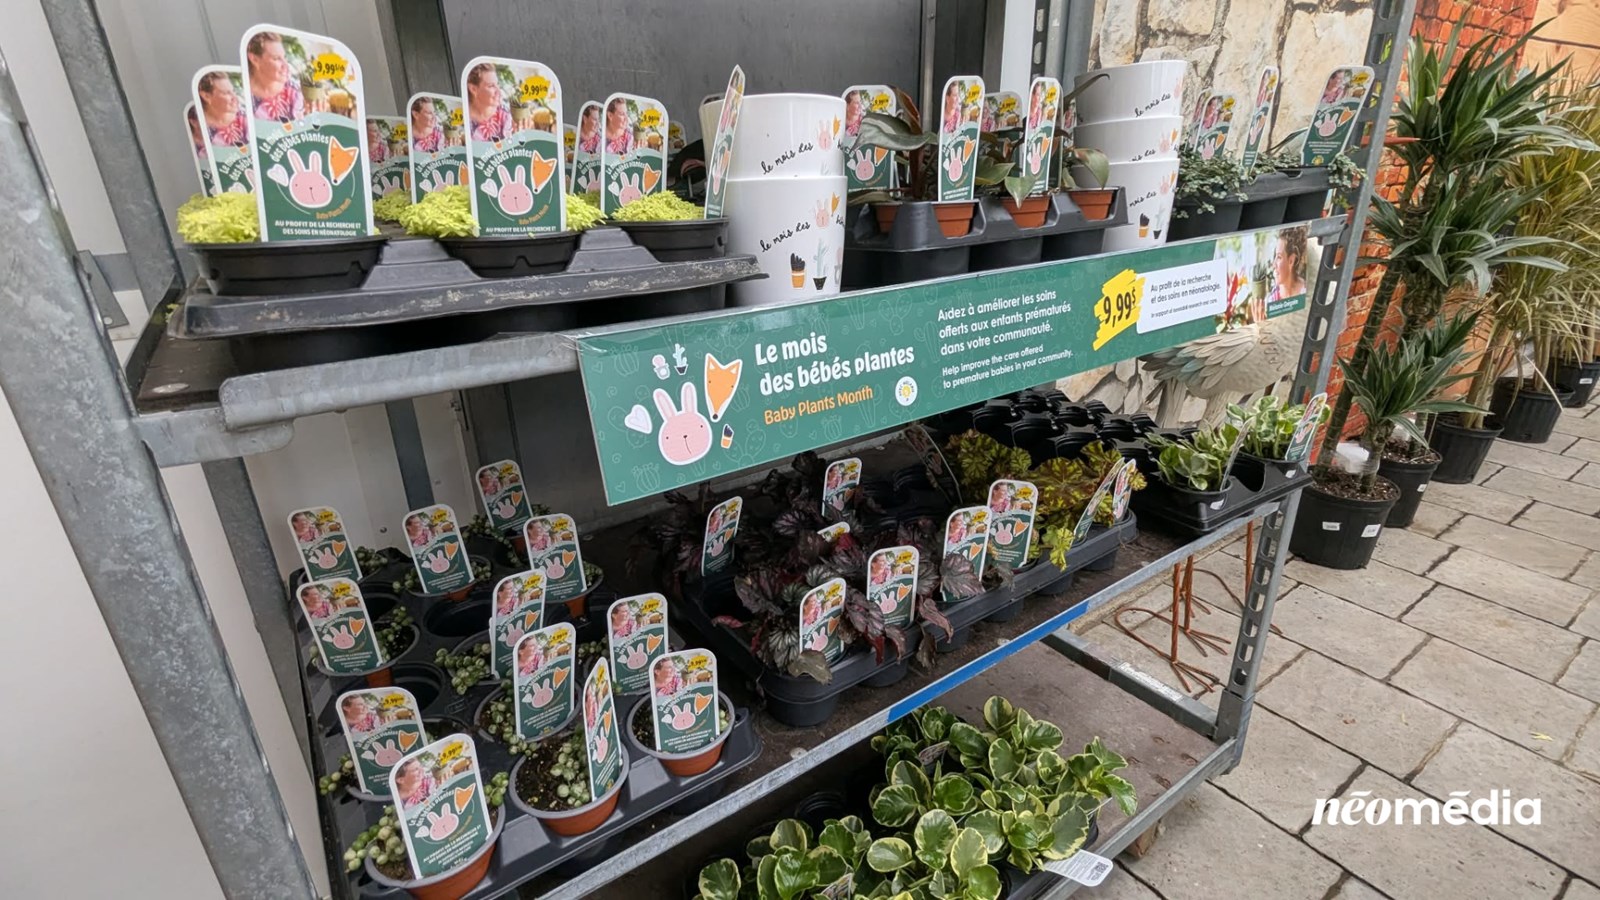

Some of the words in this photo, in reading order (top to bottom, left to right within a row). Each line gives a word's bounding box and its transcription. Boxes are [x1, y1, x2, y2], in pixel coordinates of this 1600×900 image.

[761, 159, 774, 176] le
[775, 150, 797, 166] mois
[798, 140, 814, 155] des
[285, 220, 308, 228] PROFIT
[759, 239, 771, 254] le
[772, 229, 794, 244] mois
[795, 220, 811, 234] des
[937, 308, 966, 322] Aidez
[968, 303, 975, 315] à
[977, 296, 1020, 314] améliorer
[1022, 294, 1034, 305] les
[1036, 289, 1057, 303] soins
[939, 323, 969, 339] offerts
[970, 320, 989, 332] aux
[990, 311, 1024, 328] enfants
[1025, 300, 1072, 323] prématurés
[1102, 286, 1137, 328] 9,99$
[755, 342, 778, 366] Le
[782, 331, 828, 360] mois
[940, 342, 965, 356] dans
[967, 336, 991, 350] votre
[993, 320, 1054, 344] communauté.
[759, 371, 795, 396] des
[797, 356, 852, 388] bébés
[854, 346, 915, 375] plantes
[942, 366, 960, 377] Help
[960, 358, 990, 373] improve
[991, 354, 1003, 364] the
[1004, 352, 1020, 362] care
[1020, 344, 1044, 358] offered
[943, 379, 952, 389] to
[952, 370, 990, 389] premature
[991, 364, 1015, 377] babies
[1015, 361, 1022, 370] in
[1022, 358, 1037, 372] your
[1038, 349, 1074, 365] community.
[764, 405, 796, 425] Baby
[798, 396, 835, 416] Plants
[837, 385, 873, 406] Month
